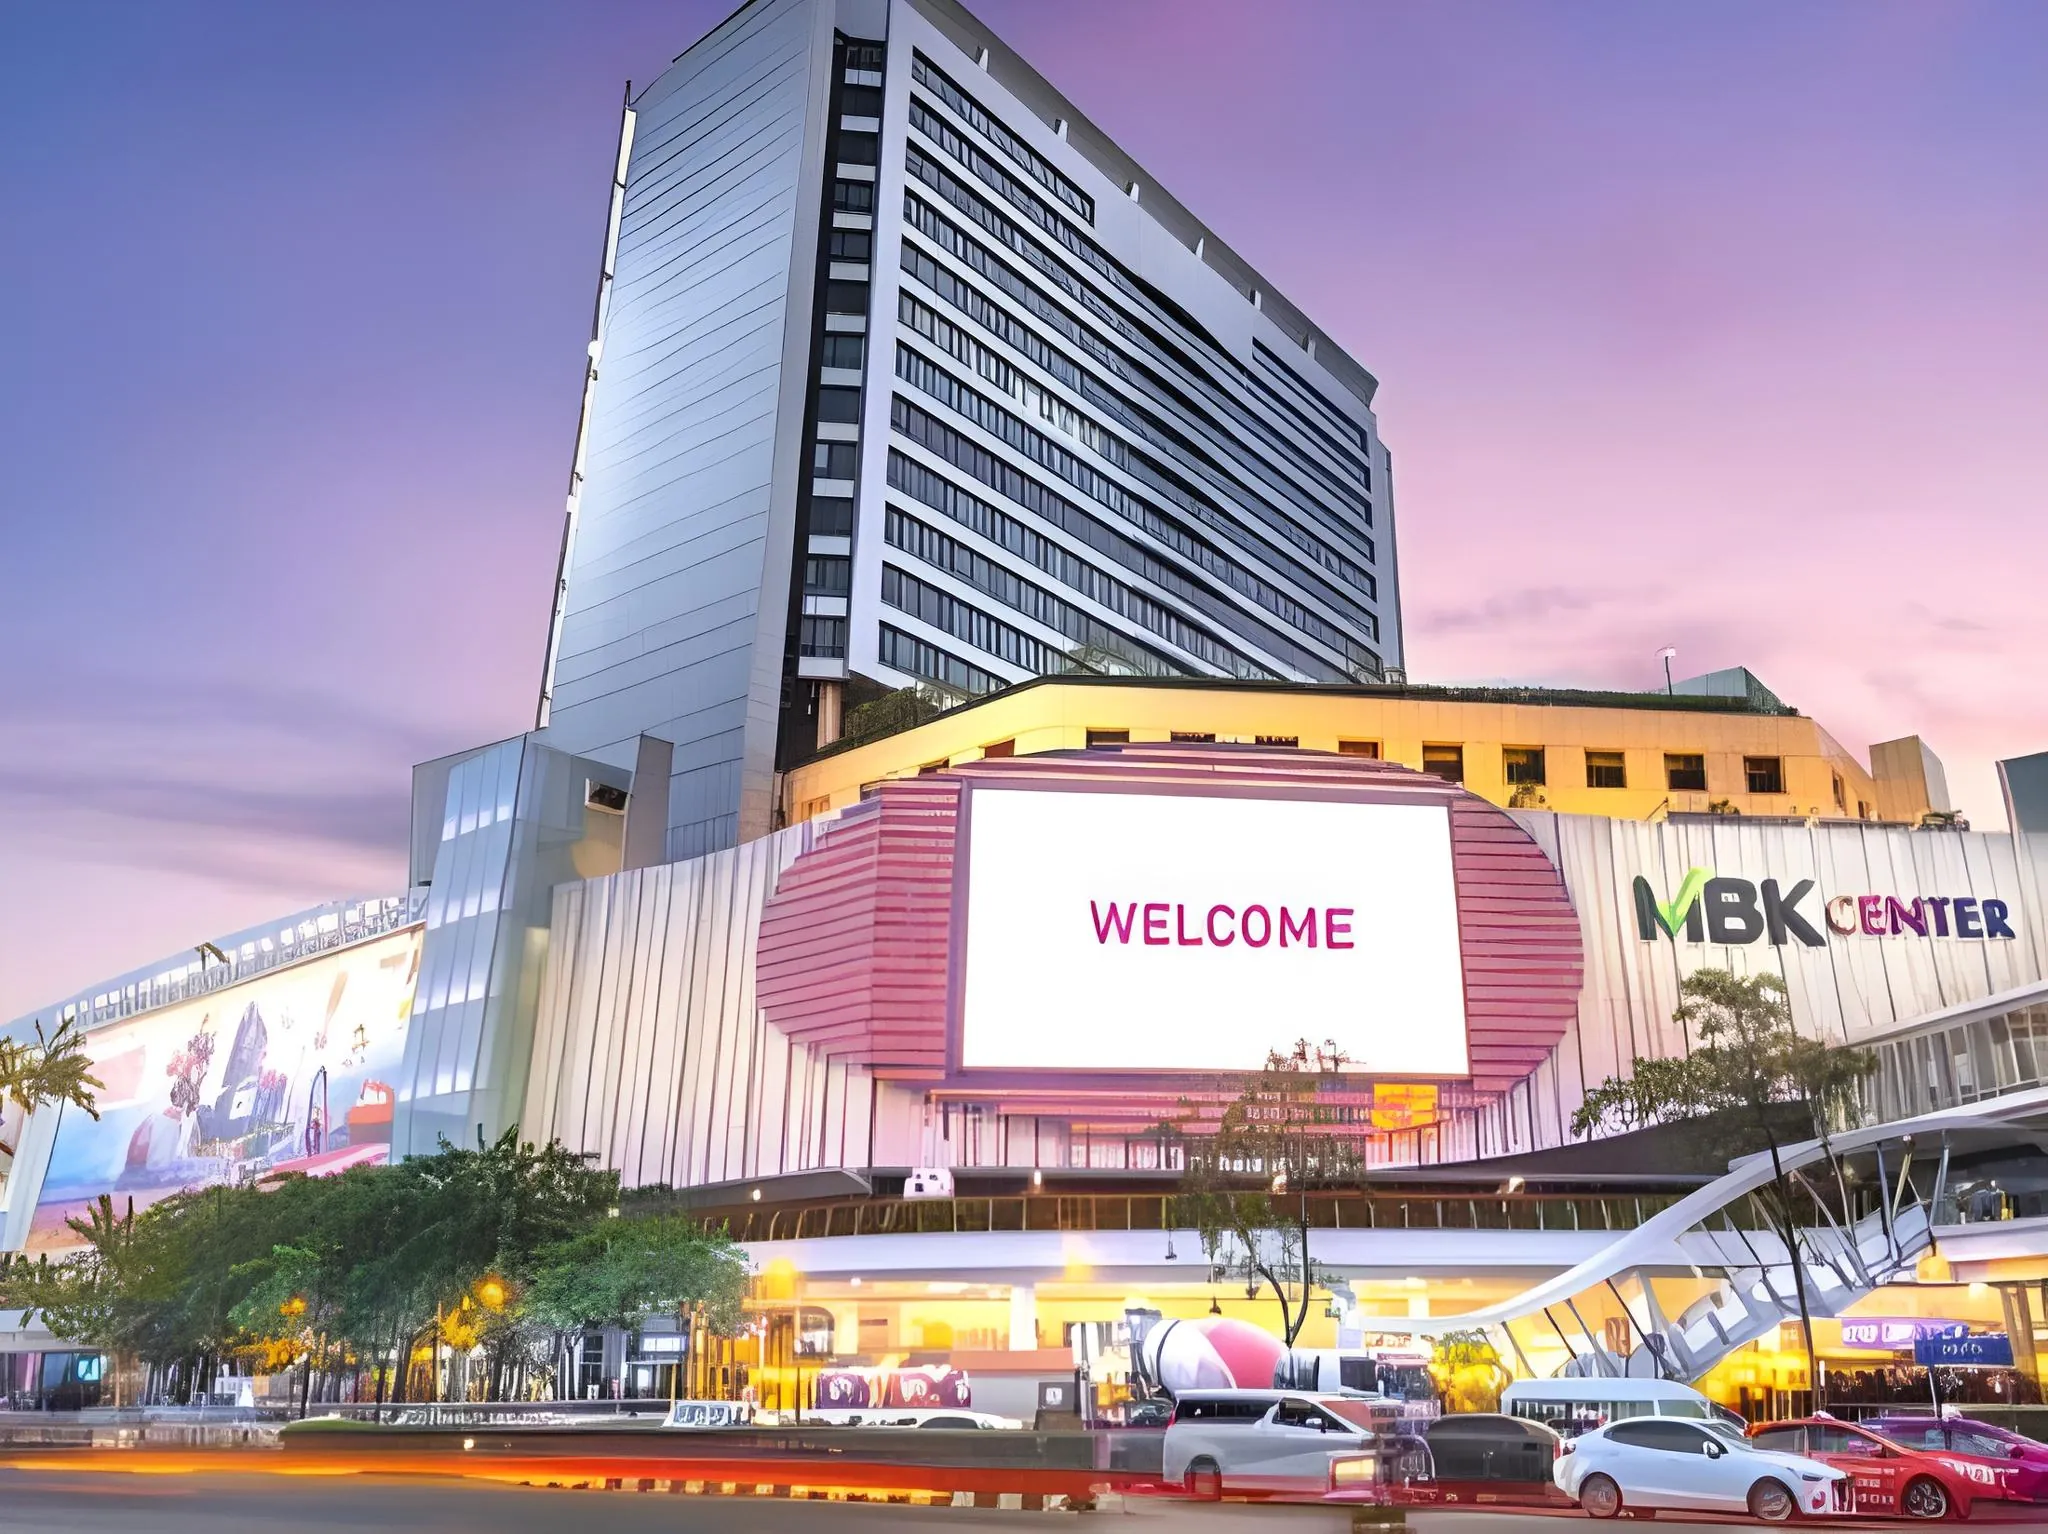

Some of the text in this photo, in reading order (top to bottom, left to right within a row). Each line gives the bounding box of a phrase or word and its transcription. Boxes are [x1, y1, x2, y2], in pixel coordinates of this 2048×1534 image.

[1090, 900, 1354, 949] WELCOME
[1632, 868, 2016, 948] MBK CENTER
